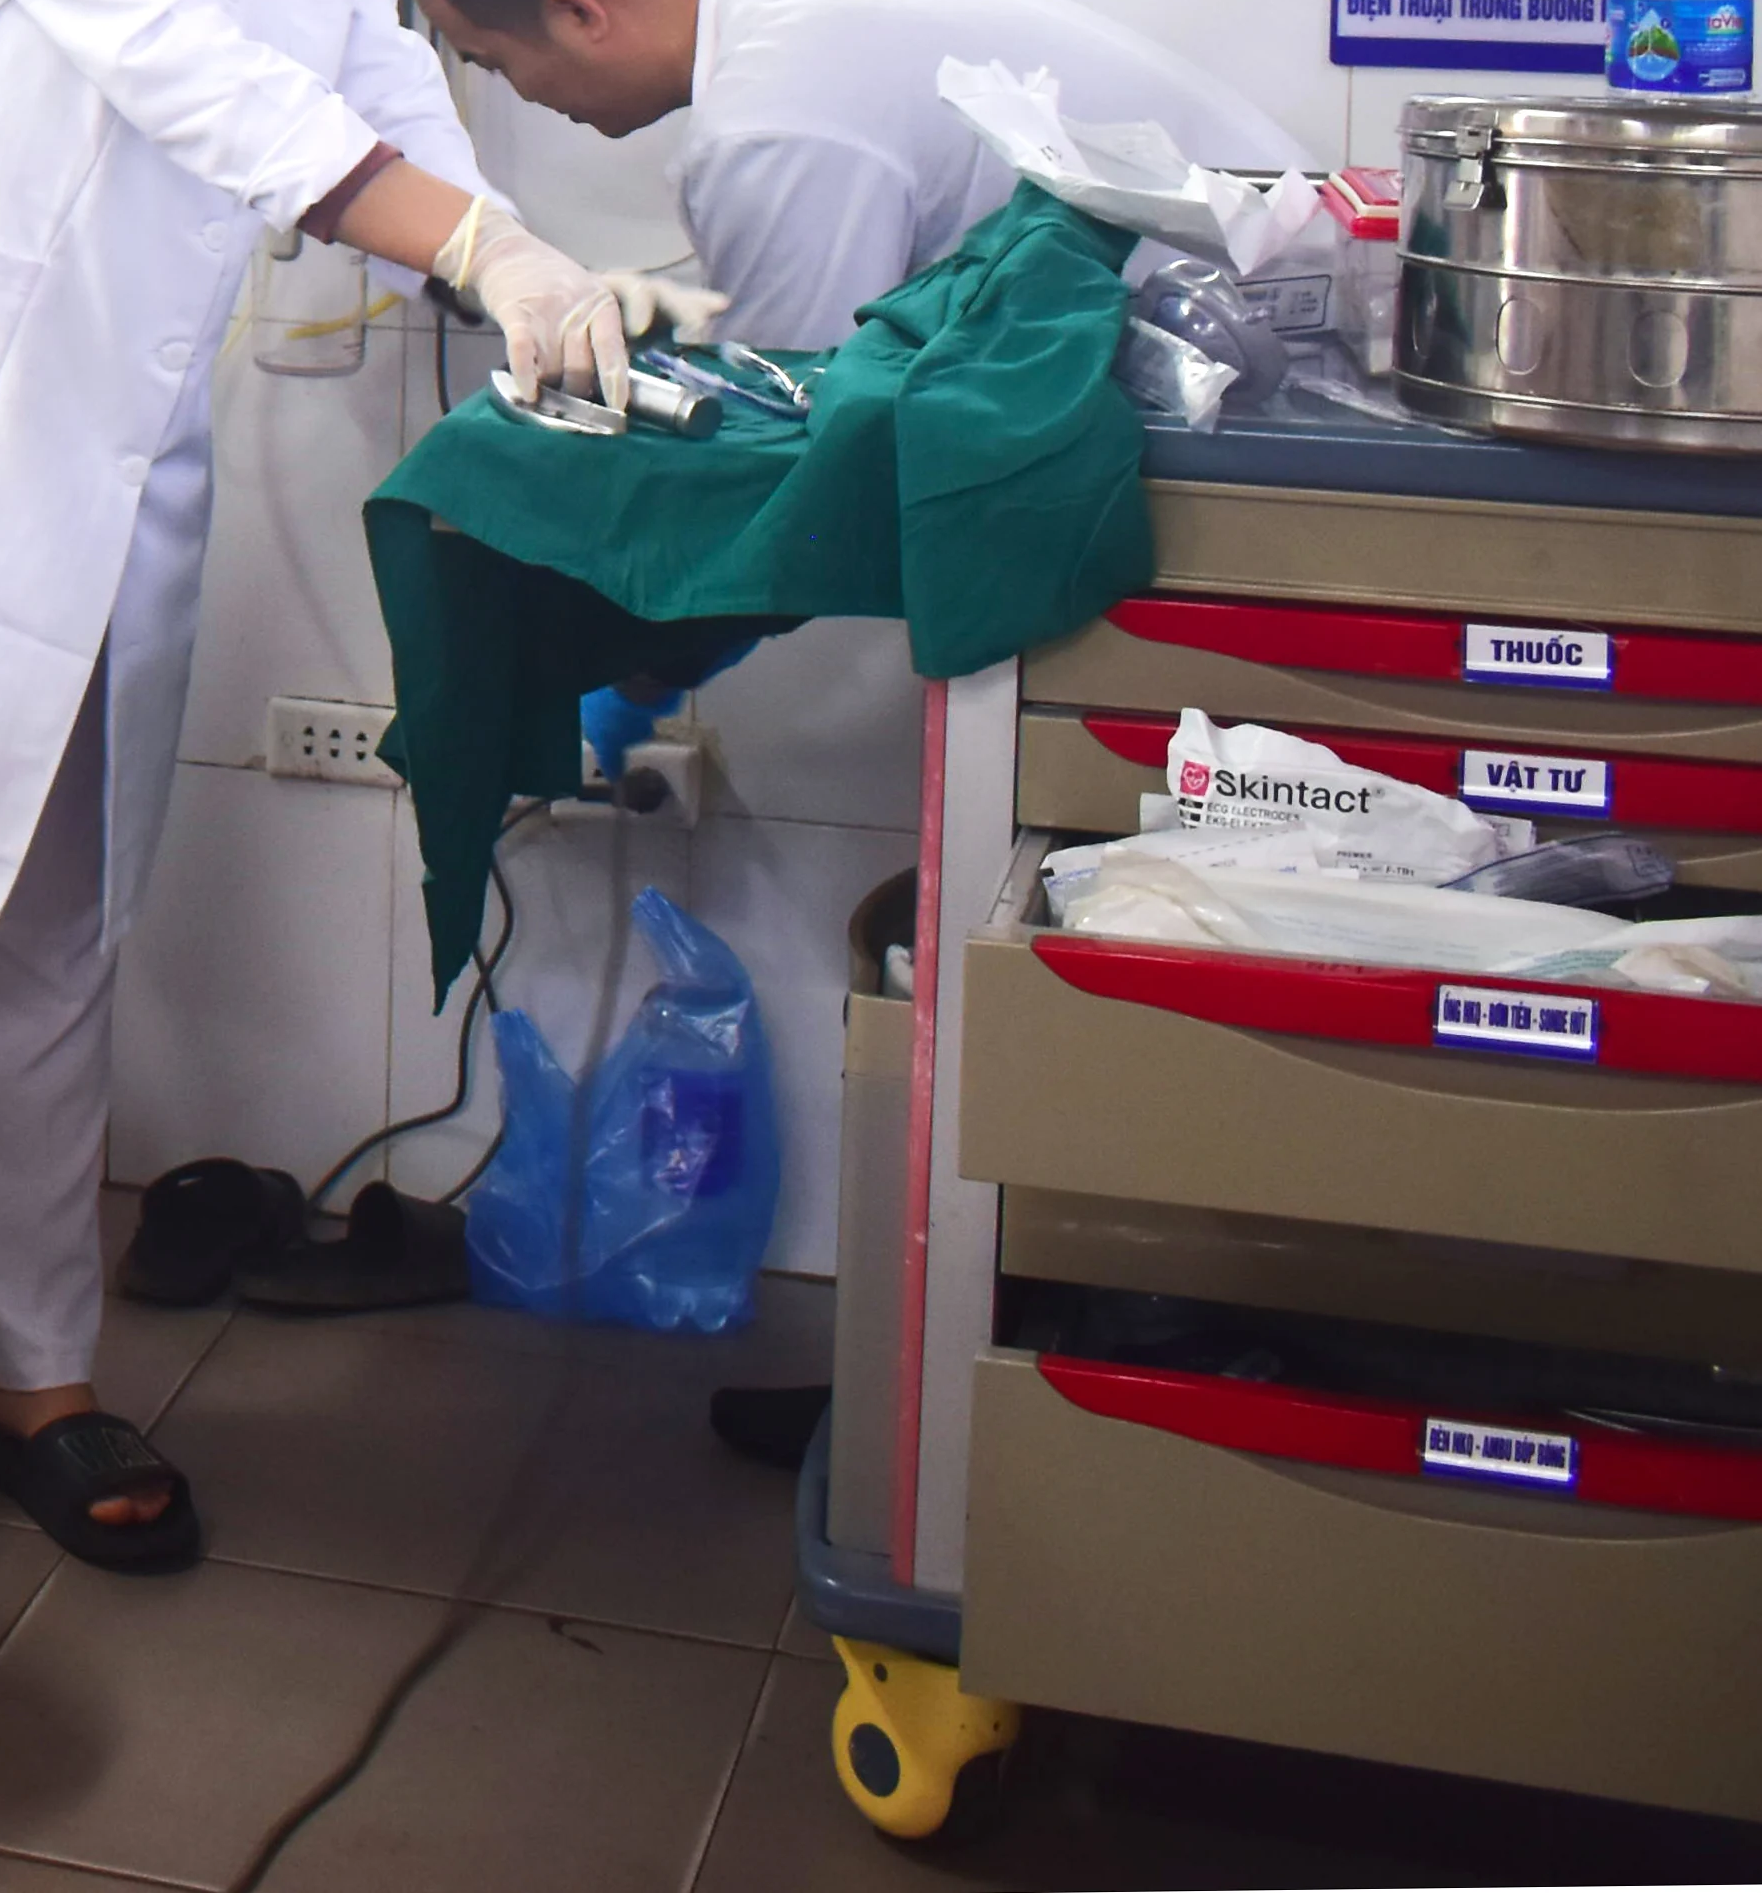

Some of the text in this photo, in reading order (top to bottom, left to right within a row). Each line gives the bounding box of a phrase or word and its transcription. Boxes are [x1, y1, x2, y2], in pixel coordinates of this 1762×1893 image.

[1490, 633, 1583, 667] THUỐC
[1215, 769, 1372, 814] Skintact
[1487, 760, 1586, 794] VẬT TƯ
[1207, 802, 1229, 815] ECG
